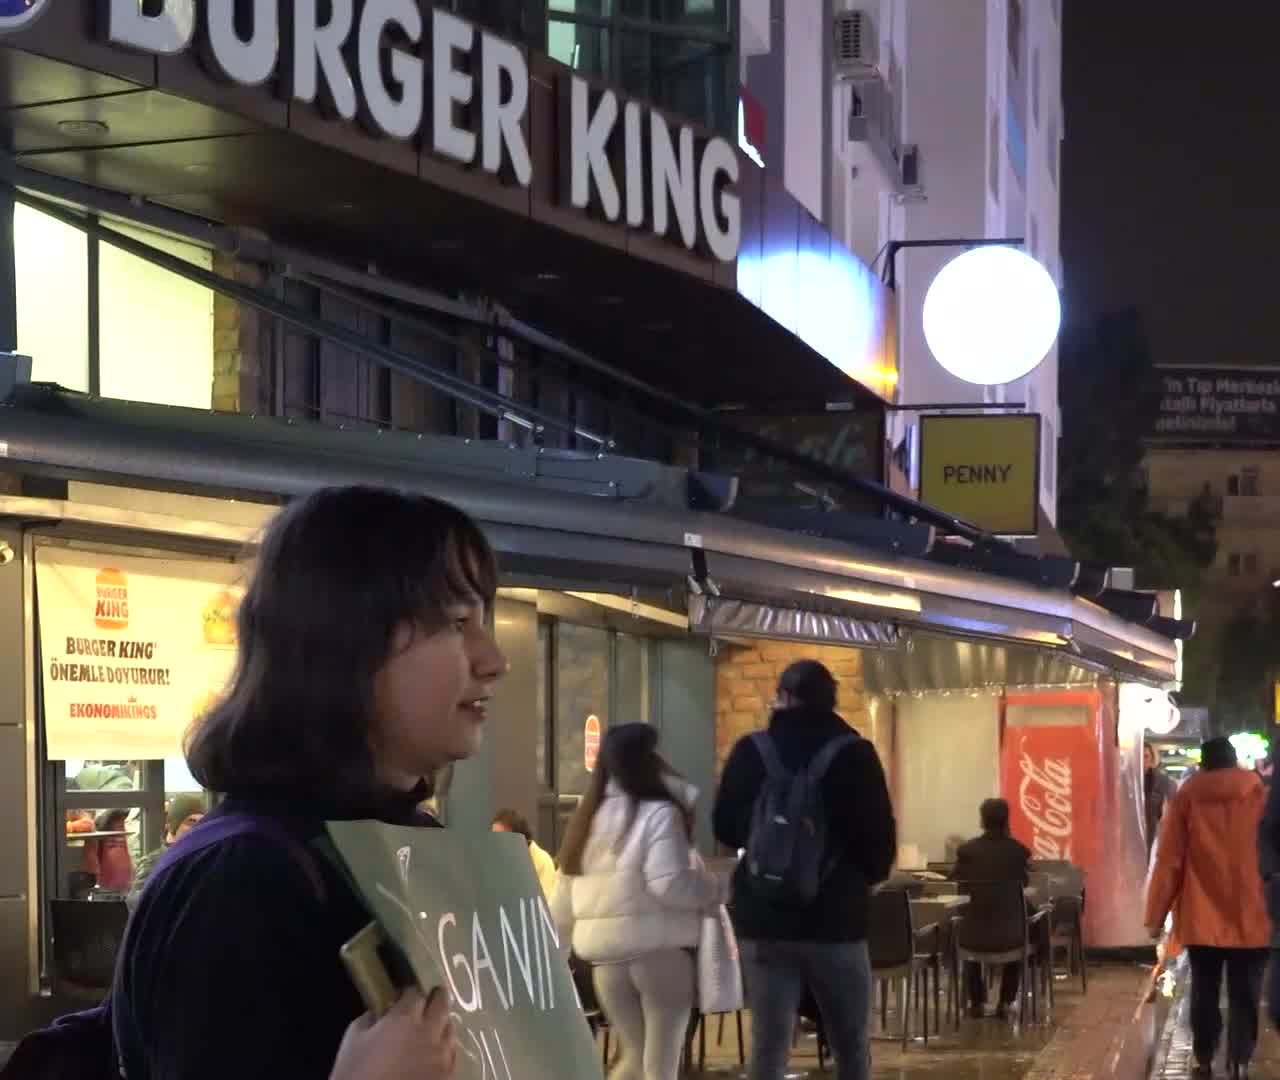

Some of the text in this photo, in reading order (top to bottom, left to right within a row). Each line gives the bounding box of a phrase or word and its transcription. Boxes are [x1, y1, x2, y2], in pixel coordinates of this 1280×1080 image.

[570, 77, 741, 263] KING
[942, 464, 1012, 484] PENNY
[96, 586, 128, 601] BURGER
[95, 600, 129, 619] KING
[66, 637, 116, 659] BURGER
[50, 657, 171, 686] ÖNEMLE DOYURUR!
